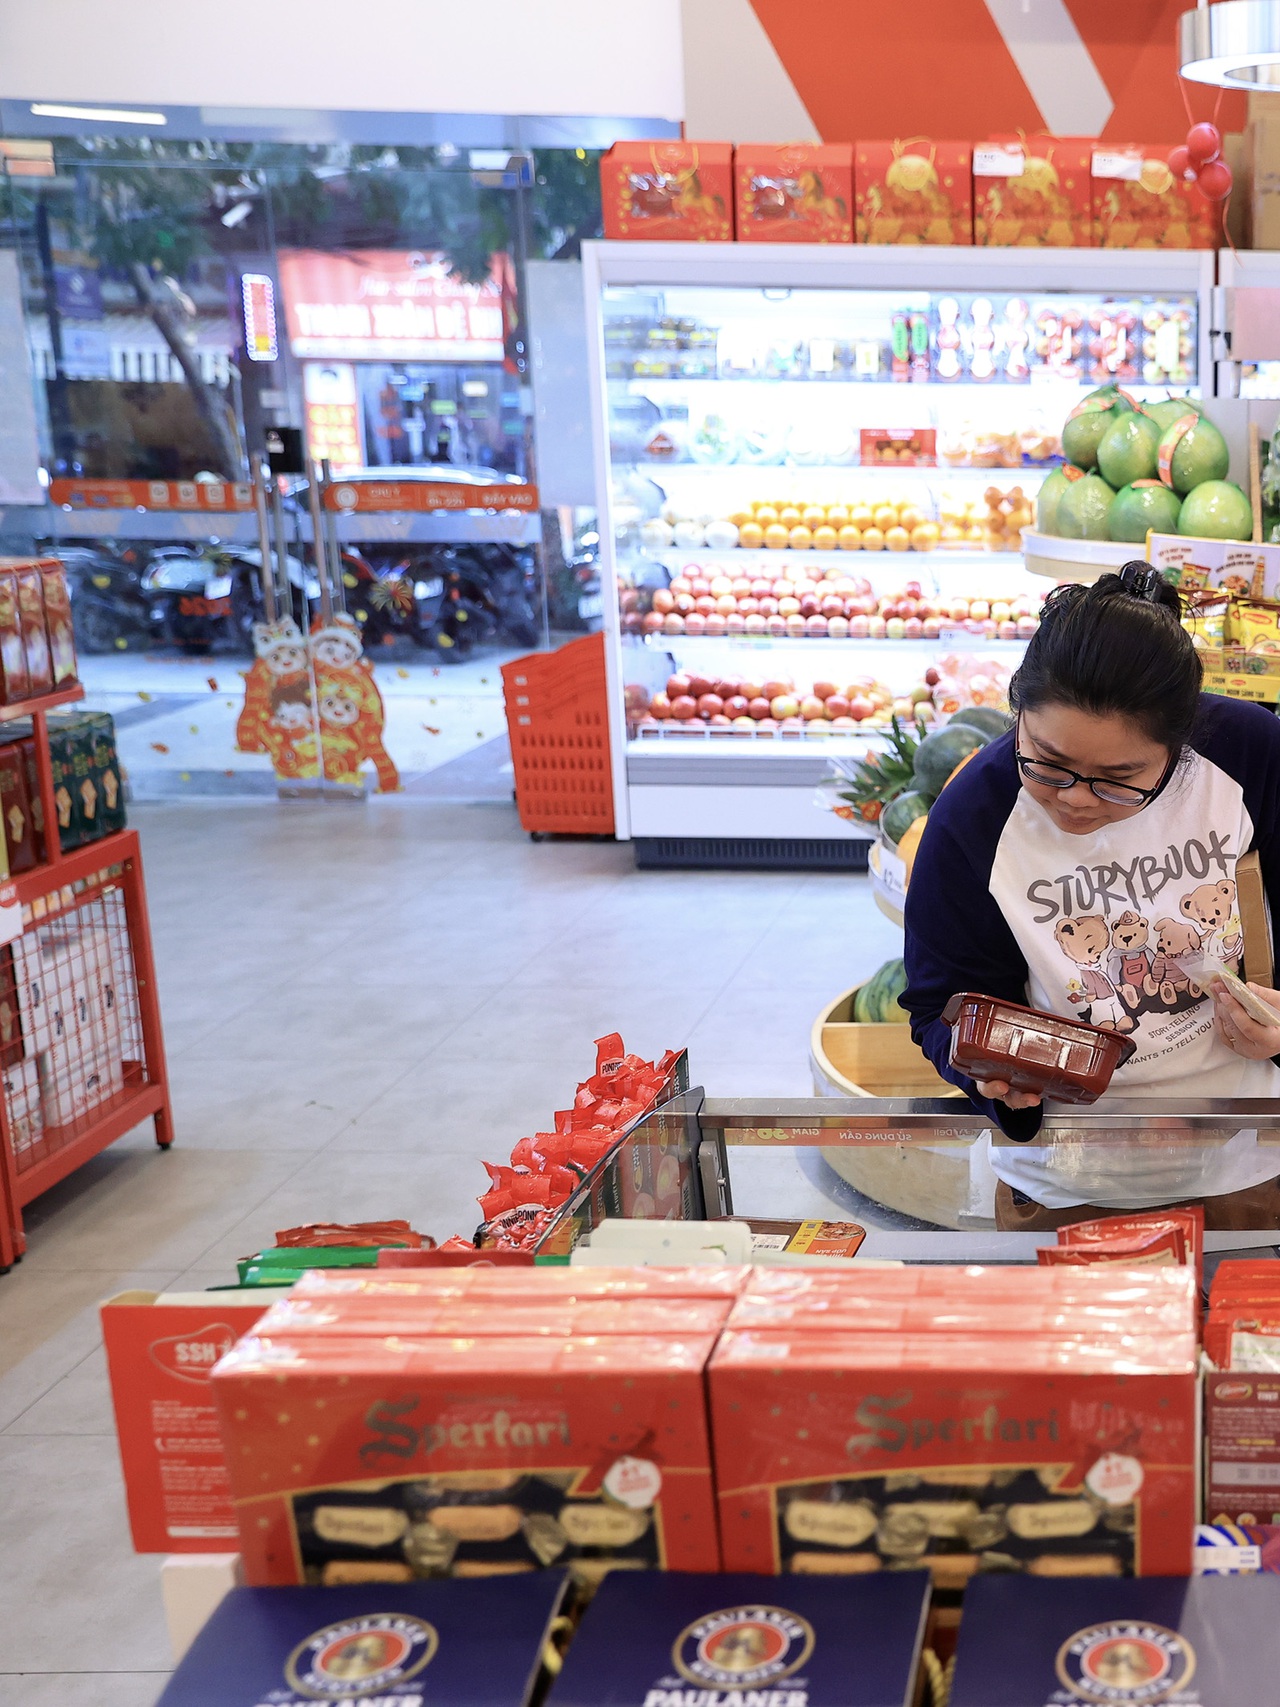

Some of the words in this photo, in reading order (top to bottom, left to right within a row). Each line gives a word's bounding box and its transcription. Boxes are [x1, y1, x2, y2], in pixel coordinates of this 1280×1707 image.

[1148, 1005, 1201, 1039] STORY-TELLING
[1165, 1019, 1198, 1042] SESSION
[1125, 1052, 1159, 1065] WANTS
[1161, 1047, 1174, 1055] TO
[1175, 1034, 1196, 1048] TELL
[1195, 1022, 1212, 1036] YOU
